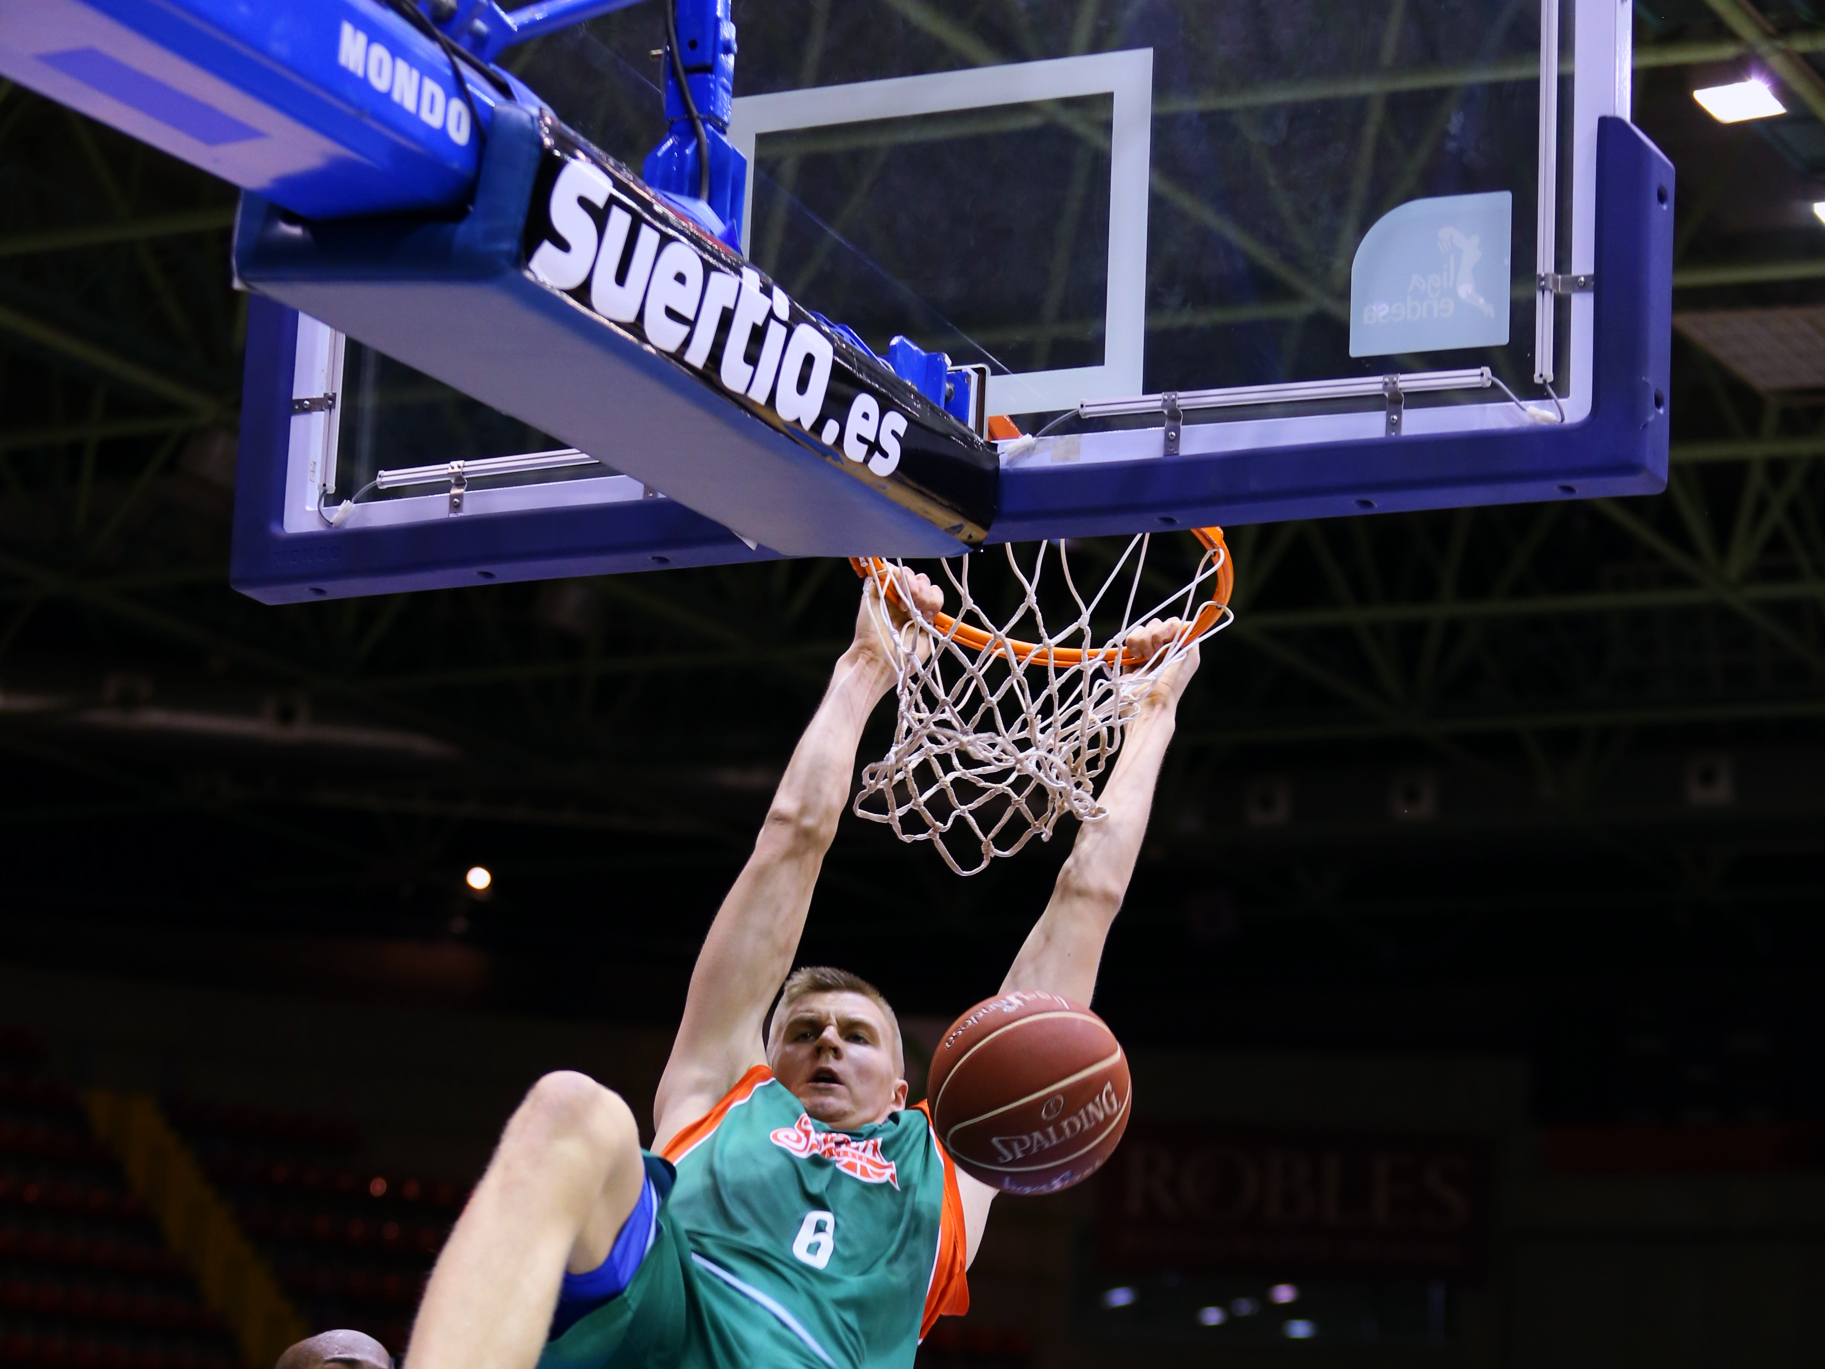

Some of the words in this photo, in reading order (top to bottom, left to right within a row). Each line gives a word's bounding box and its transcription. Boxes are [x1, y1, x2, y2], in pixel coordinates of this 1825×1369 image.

[338, 20, 471, 147] MONDO
[991, 1081, 1120, 1164] SPALDING
[1121, 1140, 1471, 1231] ROBLES
